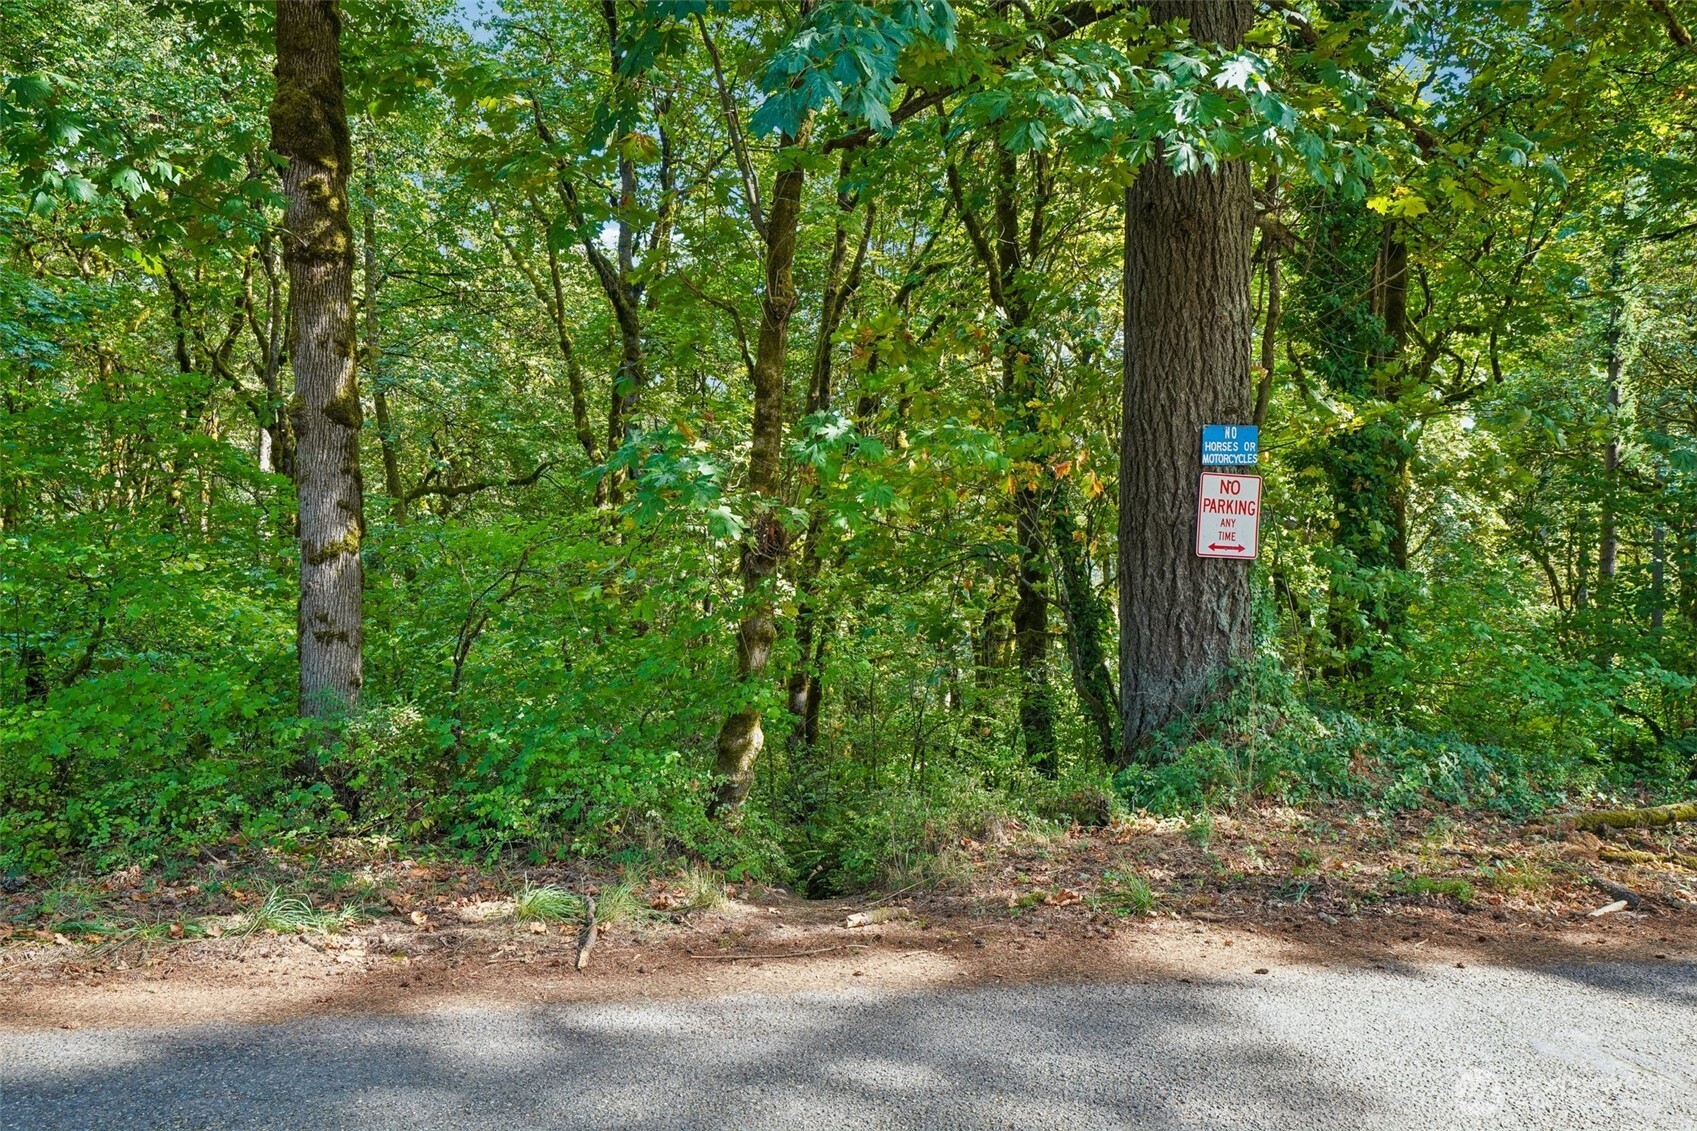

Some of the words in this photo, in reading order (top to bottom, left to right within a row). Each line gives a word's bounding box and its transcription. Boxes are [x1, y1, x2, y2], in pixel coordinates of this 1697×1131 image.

[1224, 426, 1237, 439] NO
[1205, 442, 1238, 452] HORSES
[1244, 442, 1256, 452] OR
[1202, 454, 1258, 464] MOTORCYCLES
[1220, 480, 1240, 495] NO
[1203, 498, 1256, 516] PARKING
[1220, 518, 1236, 528] ANY
[1218, 531, 1236, 542] TIME
